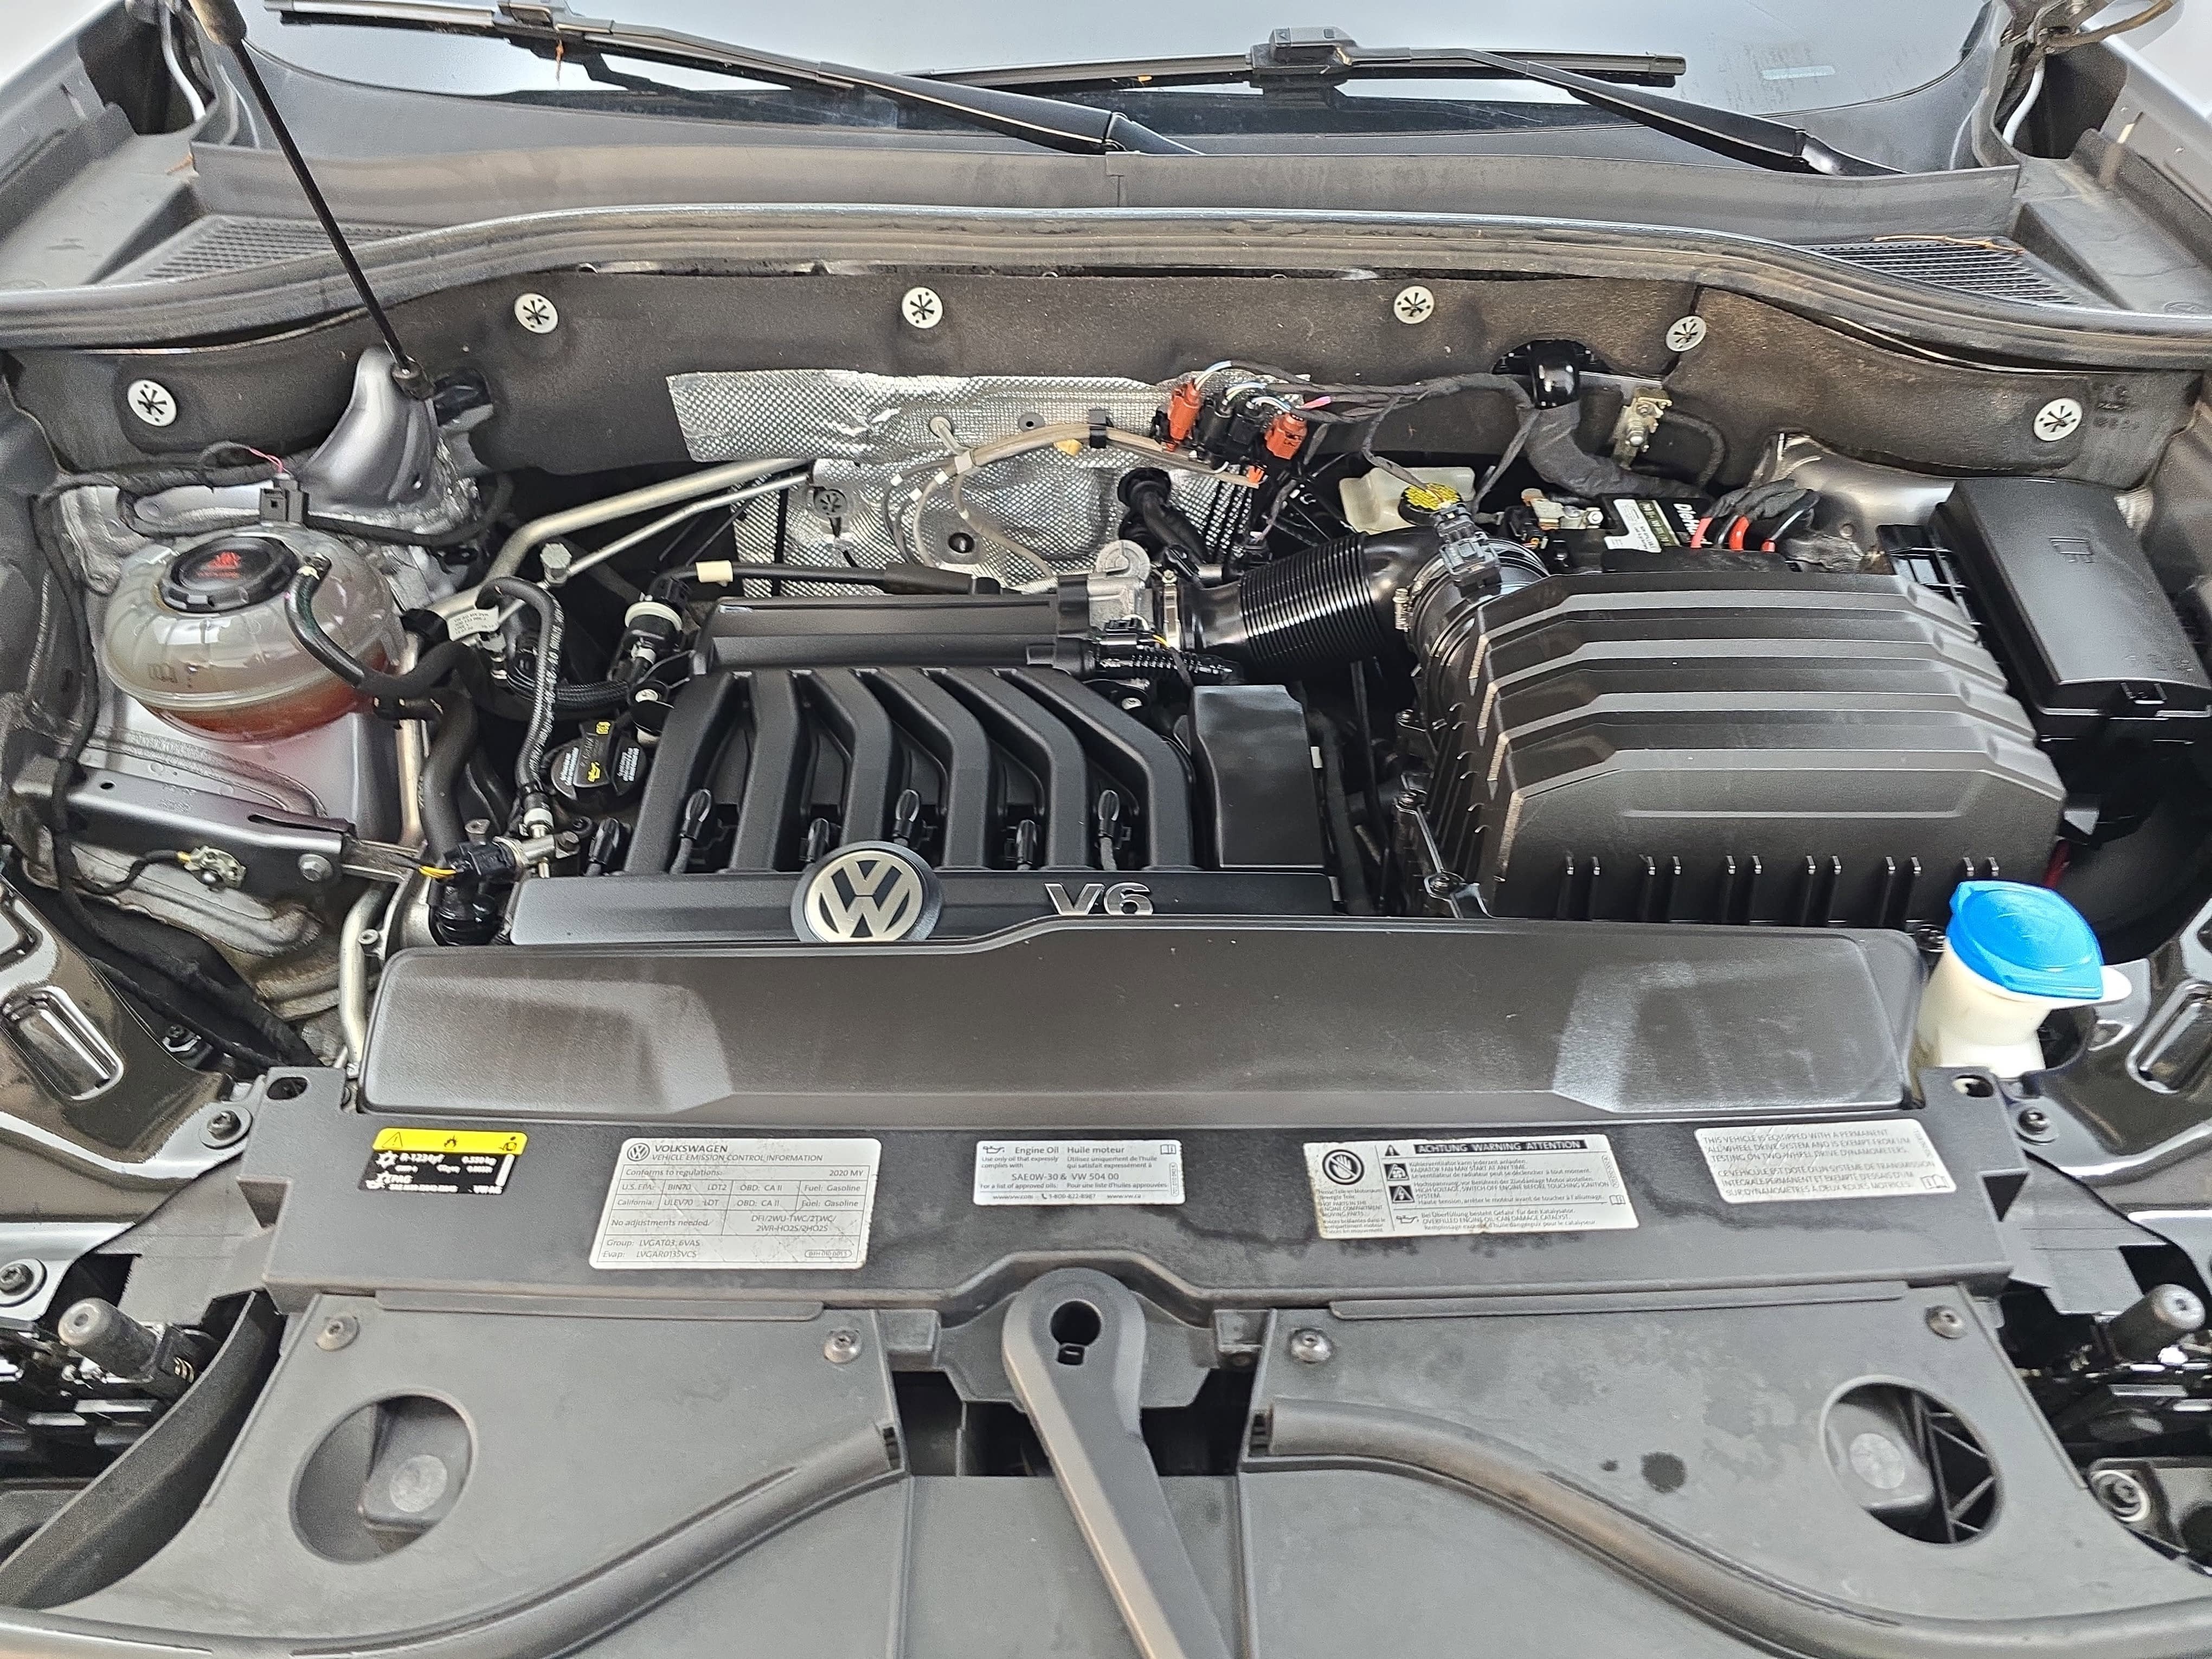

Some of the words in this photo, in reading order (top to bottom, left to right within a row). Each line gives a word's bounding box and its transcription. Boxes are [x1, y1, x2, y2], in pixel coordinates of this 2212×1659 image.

[1044, 882, 1154, 915] V6
[1840, 1129, 1888, 1137] PERMANENT
[654, 1144, 729, 1153] VOLKSWAGEN
[1015, 1146, 1045, 1155] Engine
[1418, 1143, 1468, 1153] ACHTUNG
[1471, 1142, 1522, 1151] WARNING
[1526, 1141, 1580, 1150] ATTENTION
[1712, 1154, 1746, 1162] TESTING
[676, 1168, 723, 1177] regulations:
[626, 1219, 676, 1228] adjustments
[607, 1239, 634, 1248] Group:
[603, 1250, 625, 1259] Evap:
